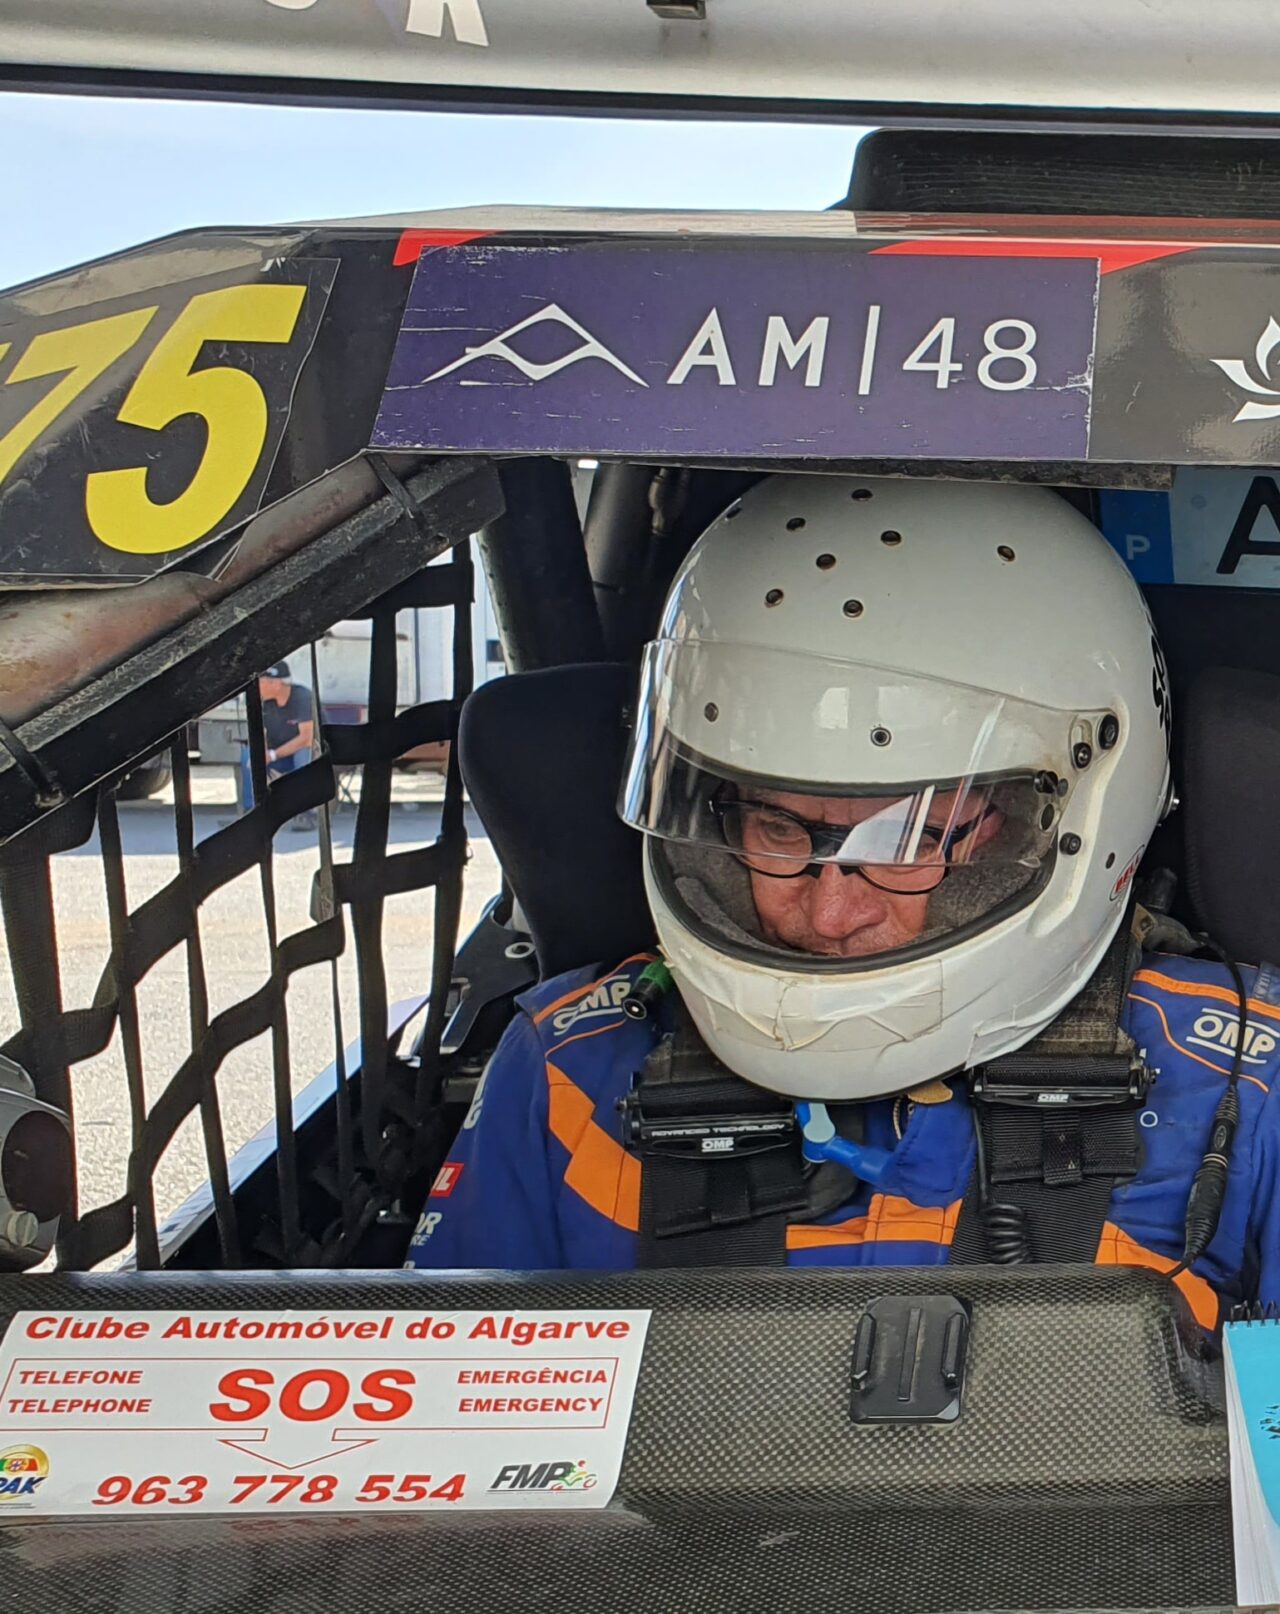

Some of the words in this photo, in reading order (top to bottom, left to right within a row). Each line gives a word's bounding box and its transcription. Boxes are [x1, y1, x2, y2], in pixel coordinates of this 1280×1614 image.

[0, 284, 307, 554] 75
[1192, 1014, 1278, 1060] OMP
[702, 1139, 734, 1150] OMP
[26, 1316, 150, 1340] Clube
[161, 1316, 394, 1340] Automóvel
[405, 1316, 456, 1340] do
[467, 1316, 630, 1346] Algarve
[18, 1371, 143, 1385] TELEFONE
[457, 1367, 607, 1385] EMERGÊNCIA
[8, 1399, 153, 1414] TELEPHONE
[209, 1368, 417, 1422] SOS
[458, 1398, 604, 1413] EMERGENCY
[91, 1475, 209, 1506] 963
[229, 1475, 339, 1505] 778
[355, 1473, 467, 1503] 554
[490, 1462, 576, 1490] FMP
